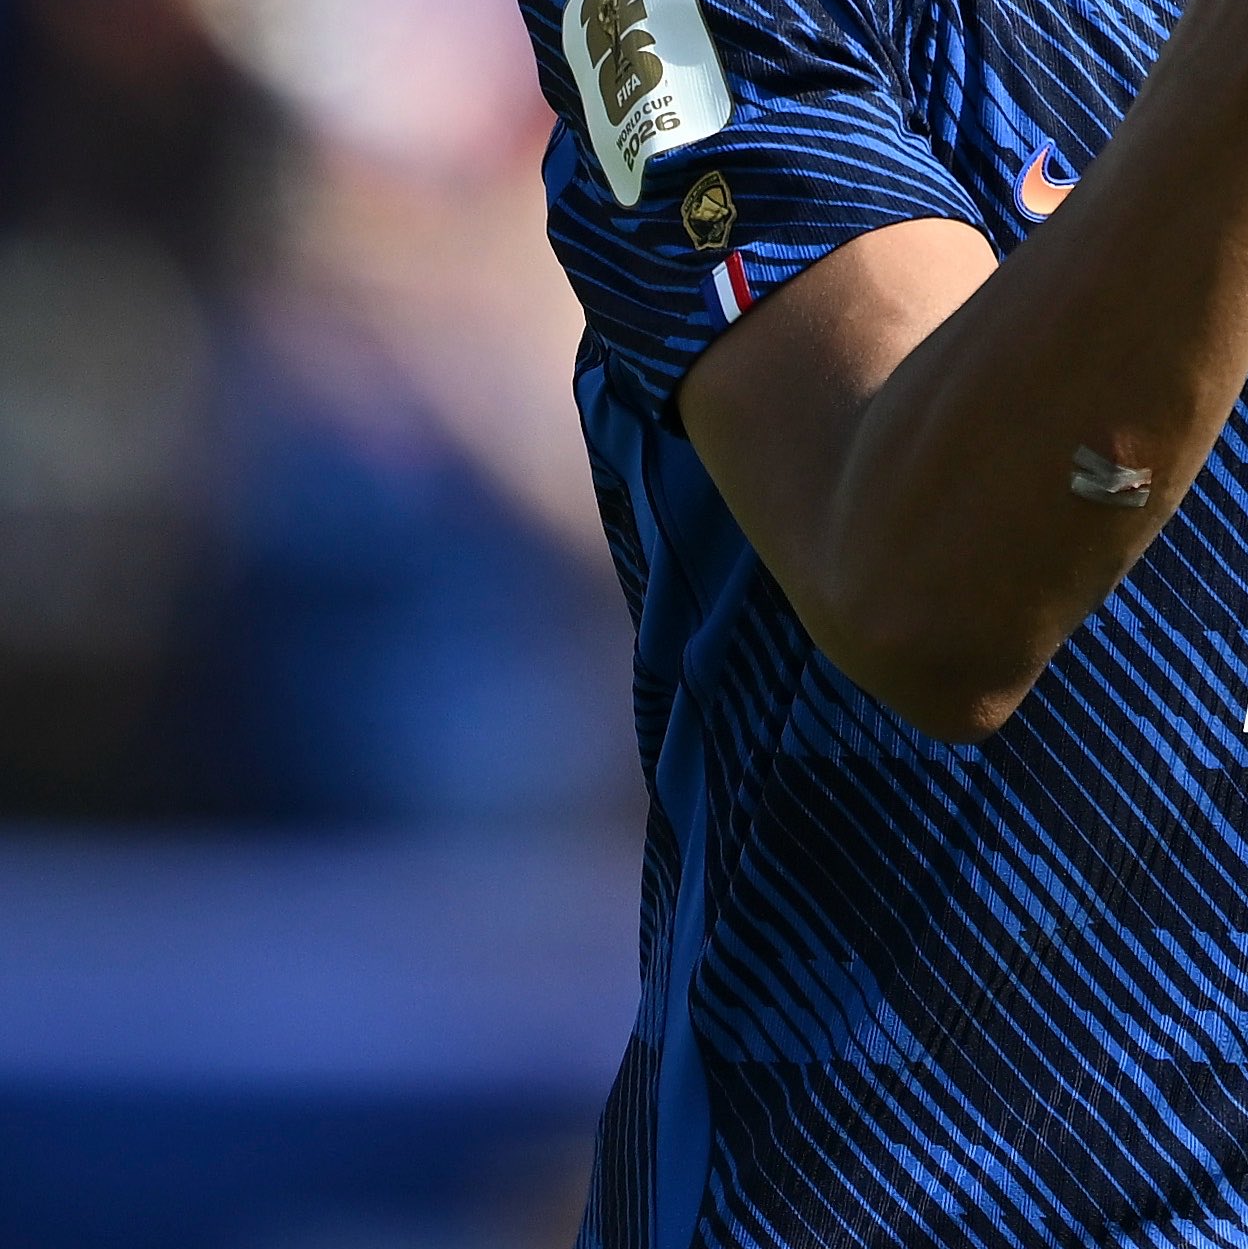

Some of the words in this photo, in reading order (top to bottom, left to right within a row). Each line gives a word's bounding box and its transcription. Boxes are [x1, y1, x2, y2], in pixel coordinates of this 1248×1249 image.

[616, 73, 642, 108] FIFA
[615, 109, 642, 151] WORLD
[642, 95, 674, 115] CUP
[623, 111, 681, 173] 2026
